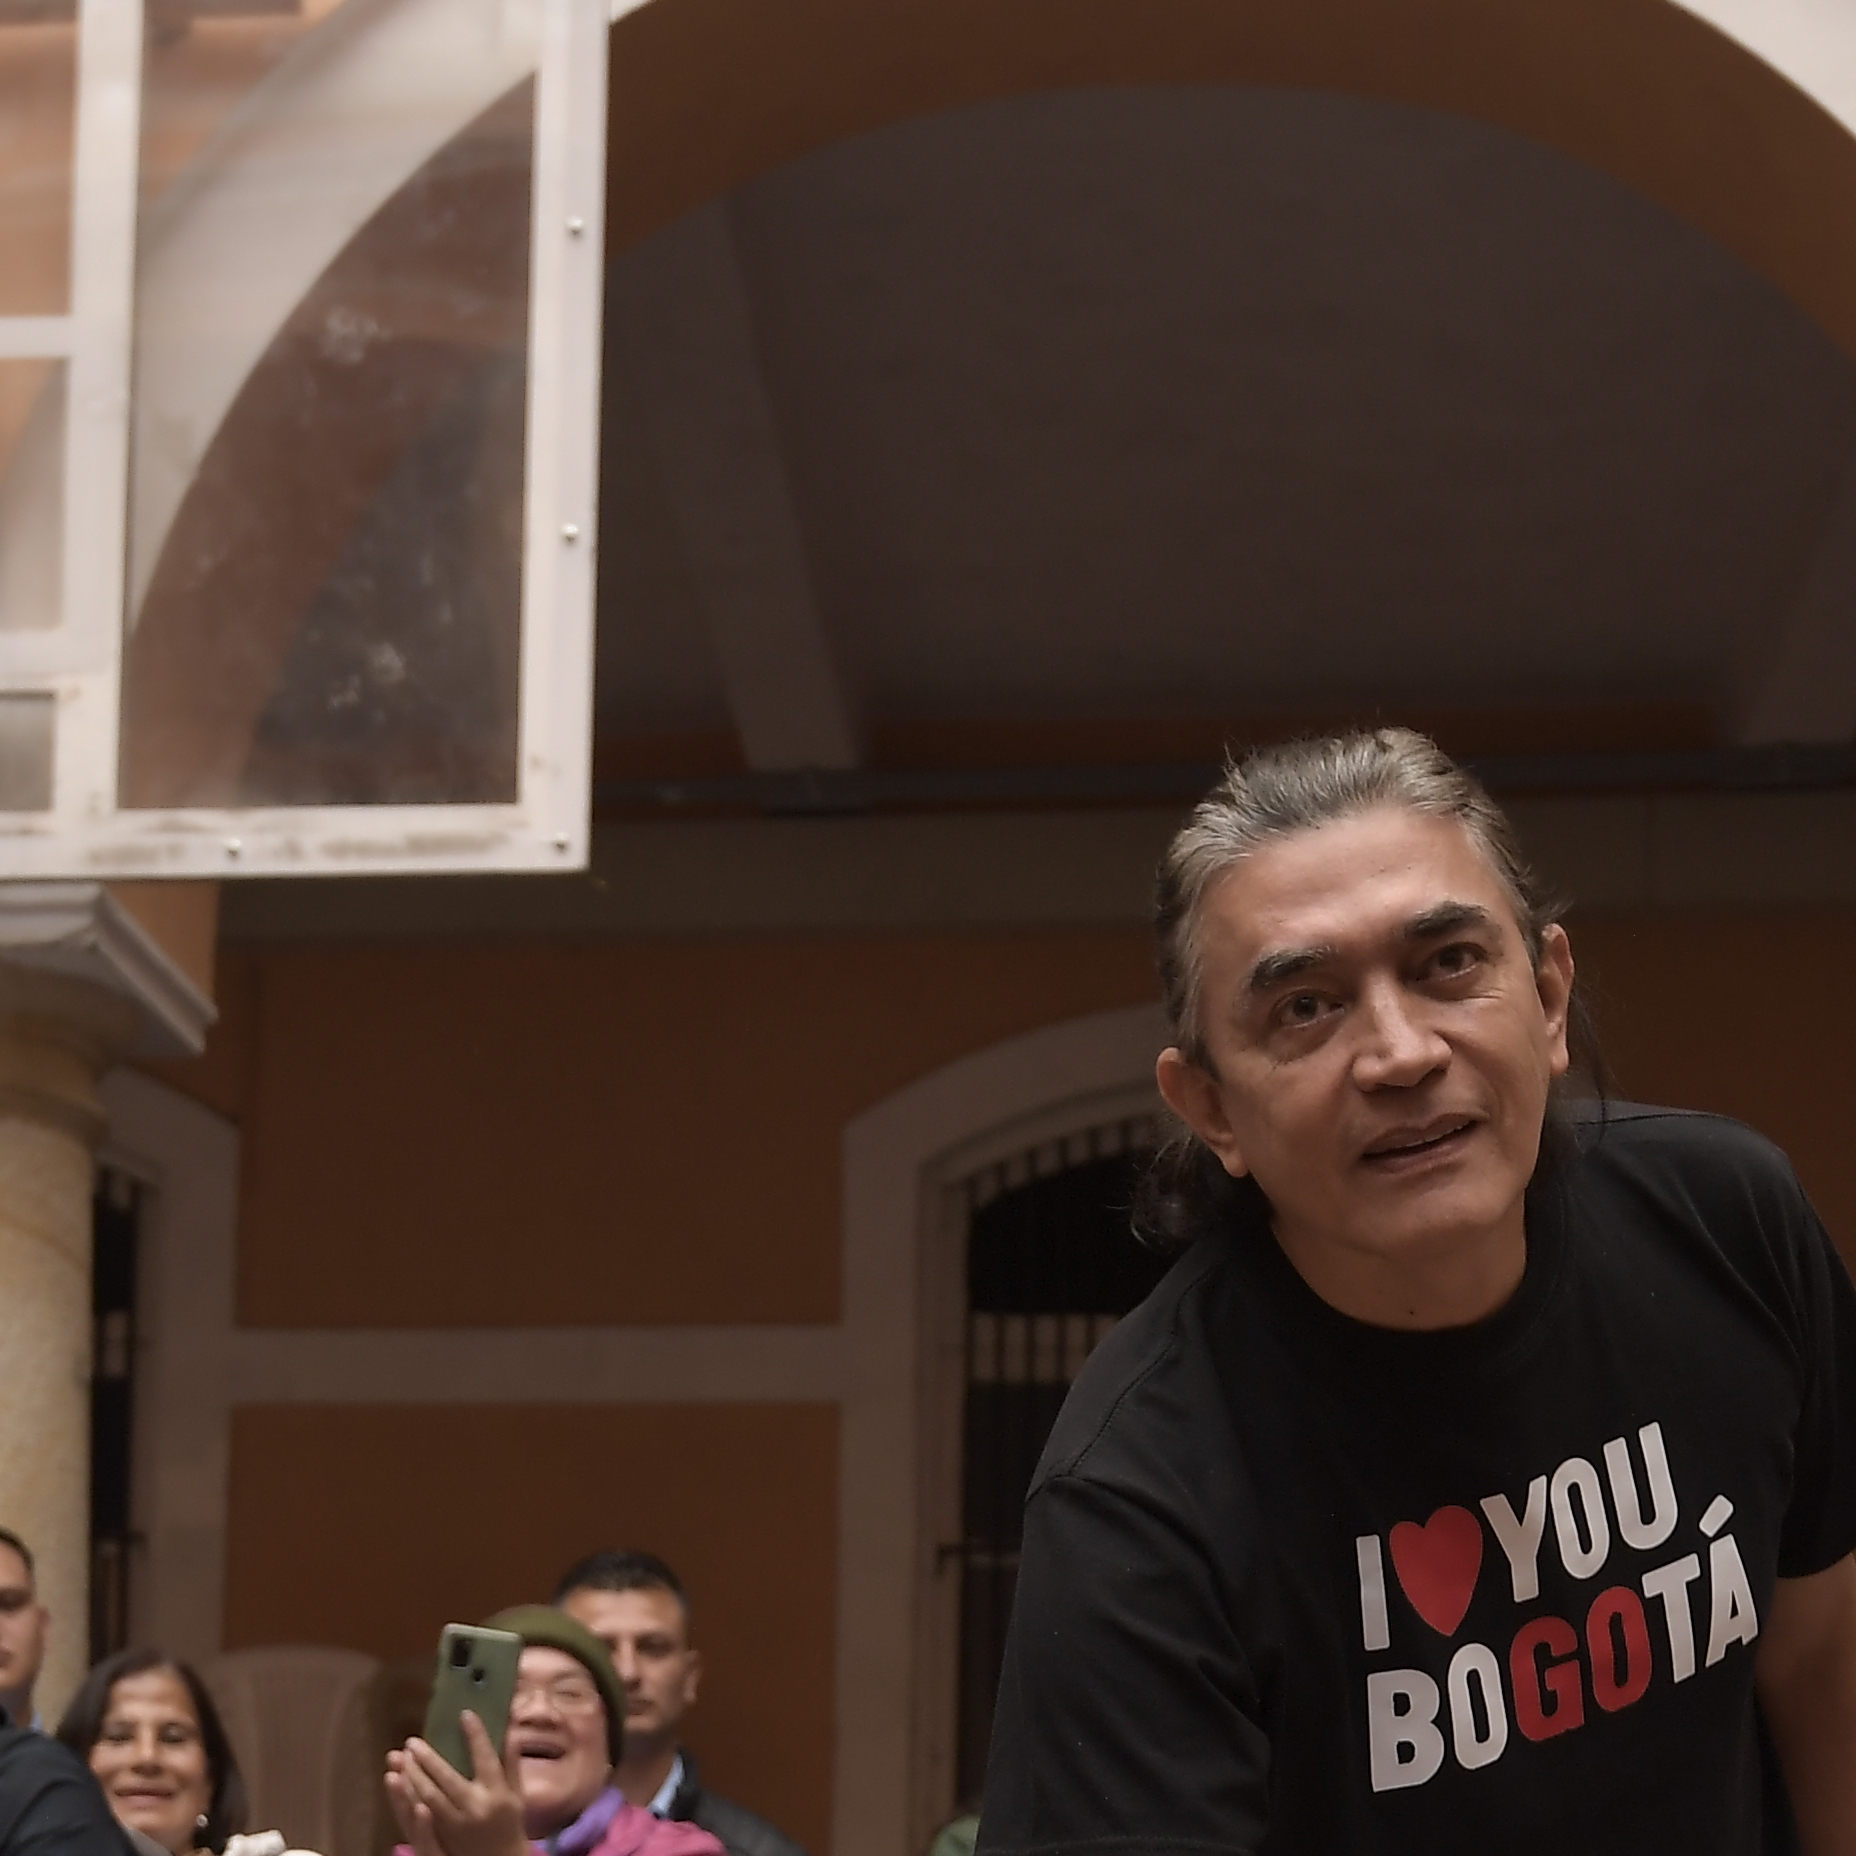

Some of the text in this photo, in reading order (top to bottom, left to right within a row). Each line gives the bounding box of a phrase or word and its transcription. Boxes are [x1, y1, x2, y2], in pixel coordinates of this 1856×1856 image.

[1355, 1421, 1679, 1652] I YOU
[1366, 1494, 1760, 1794] BOGOTÁ
